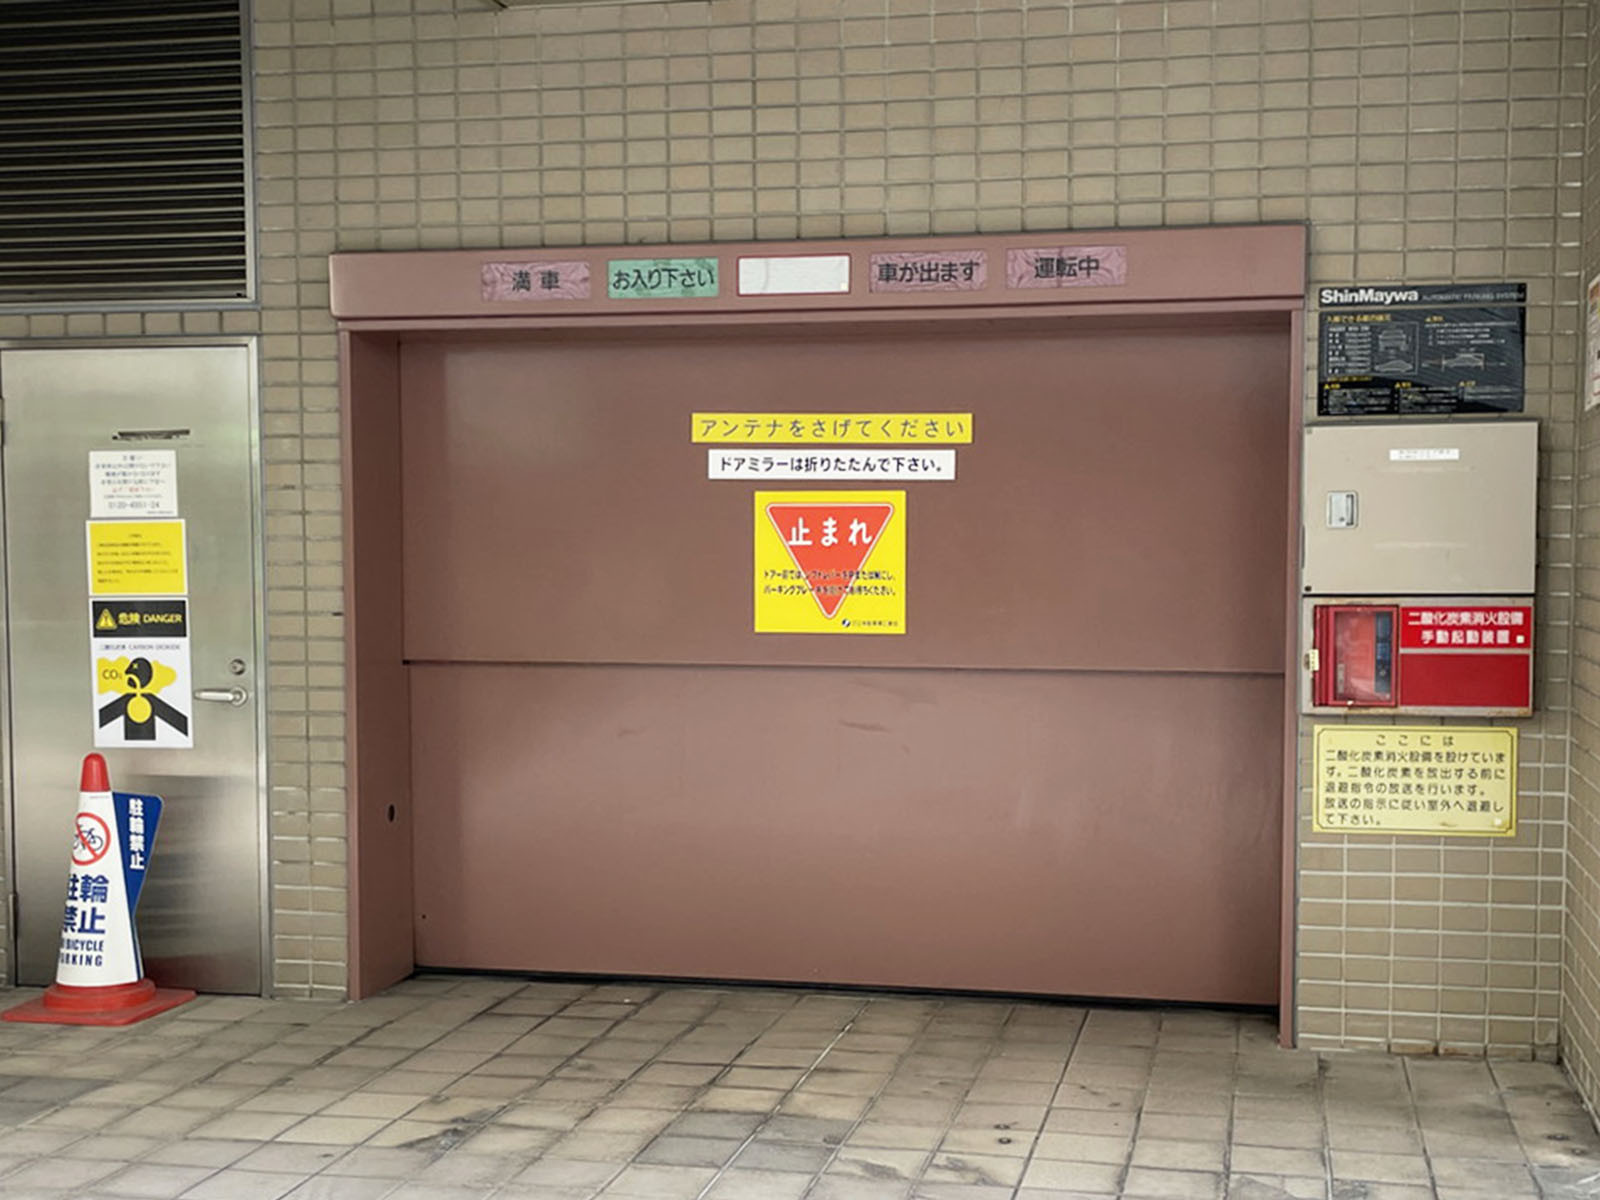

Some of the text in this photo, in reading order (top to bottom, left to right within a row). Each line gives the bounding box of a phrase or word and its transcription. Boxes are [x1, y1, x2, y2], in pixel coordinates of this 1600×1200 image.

[877, 261, 981, 283] 車が出ます
[1034, 255, 1099, 279] 運転中
[511, 269, 561, 291] 満車
[611, 267, 715, 291] お入り下さい
[1321, 288, 1418, 304] ShinMaywa
[700, 418, 964, 438] アンテナをさげてください
[720, 456, 942, 473] ドアミラーは折りたたんで下さい。
[788, 517, 872, 546] 止まれ
[118, 612, 182, 625] 危険 DANGER
[1408, 611, 1524, 626] 二酸化炭素消火設備
[1421, 629, 1510, 644] 手動起動装置
[1376, 734, 1455, 747] ここには
[1325, 750, 1505, 764] 二酸化炭素消火設備を設けていま
[1325, 766, 1505, 780] す。二酸化炭素を放出する前に
[1325, 813, 1381, 825] て下さい。
[129, 798, 145, 870] 駐輪禁止
[60, 952, 103, 967] RKING
